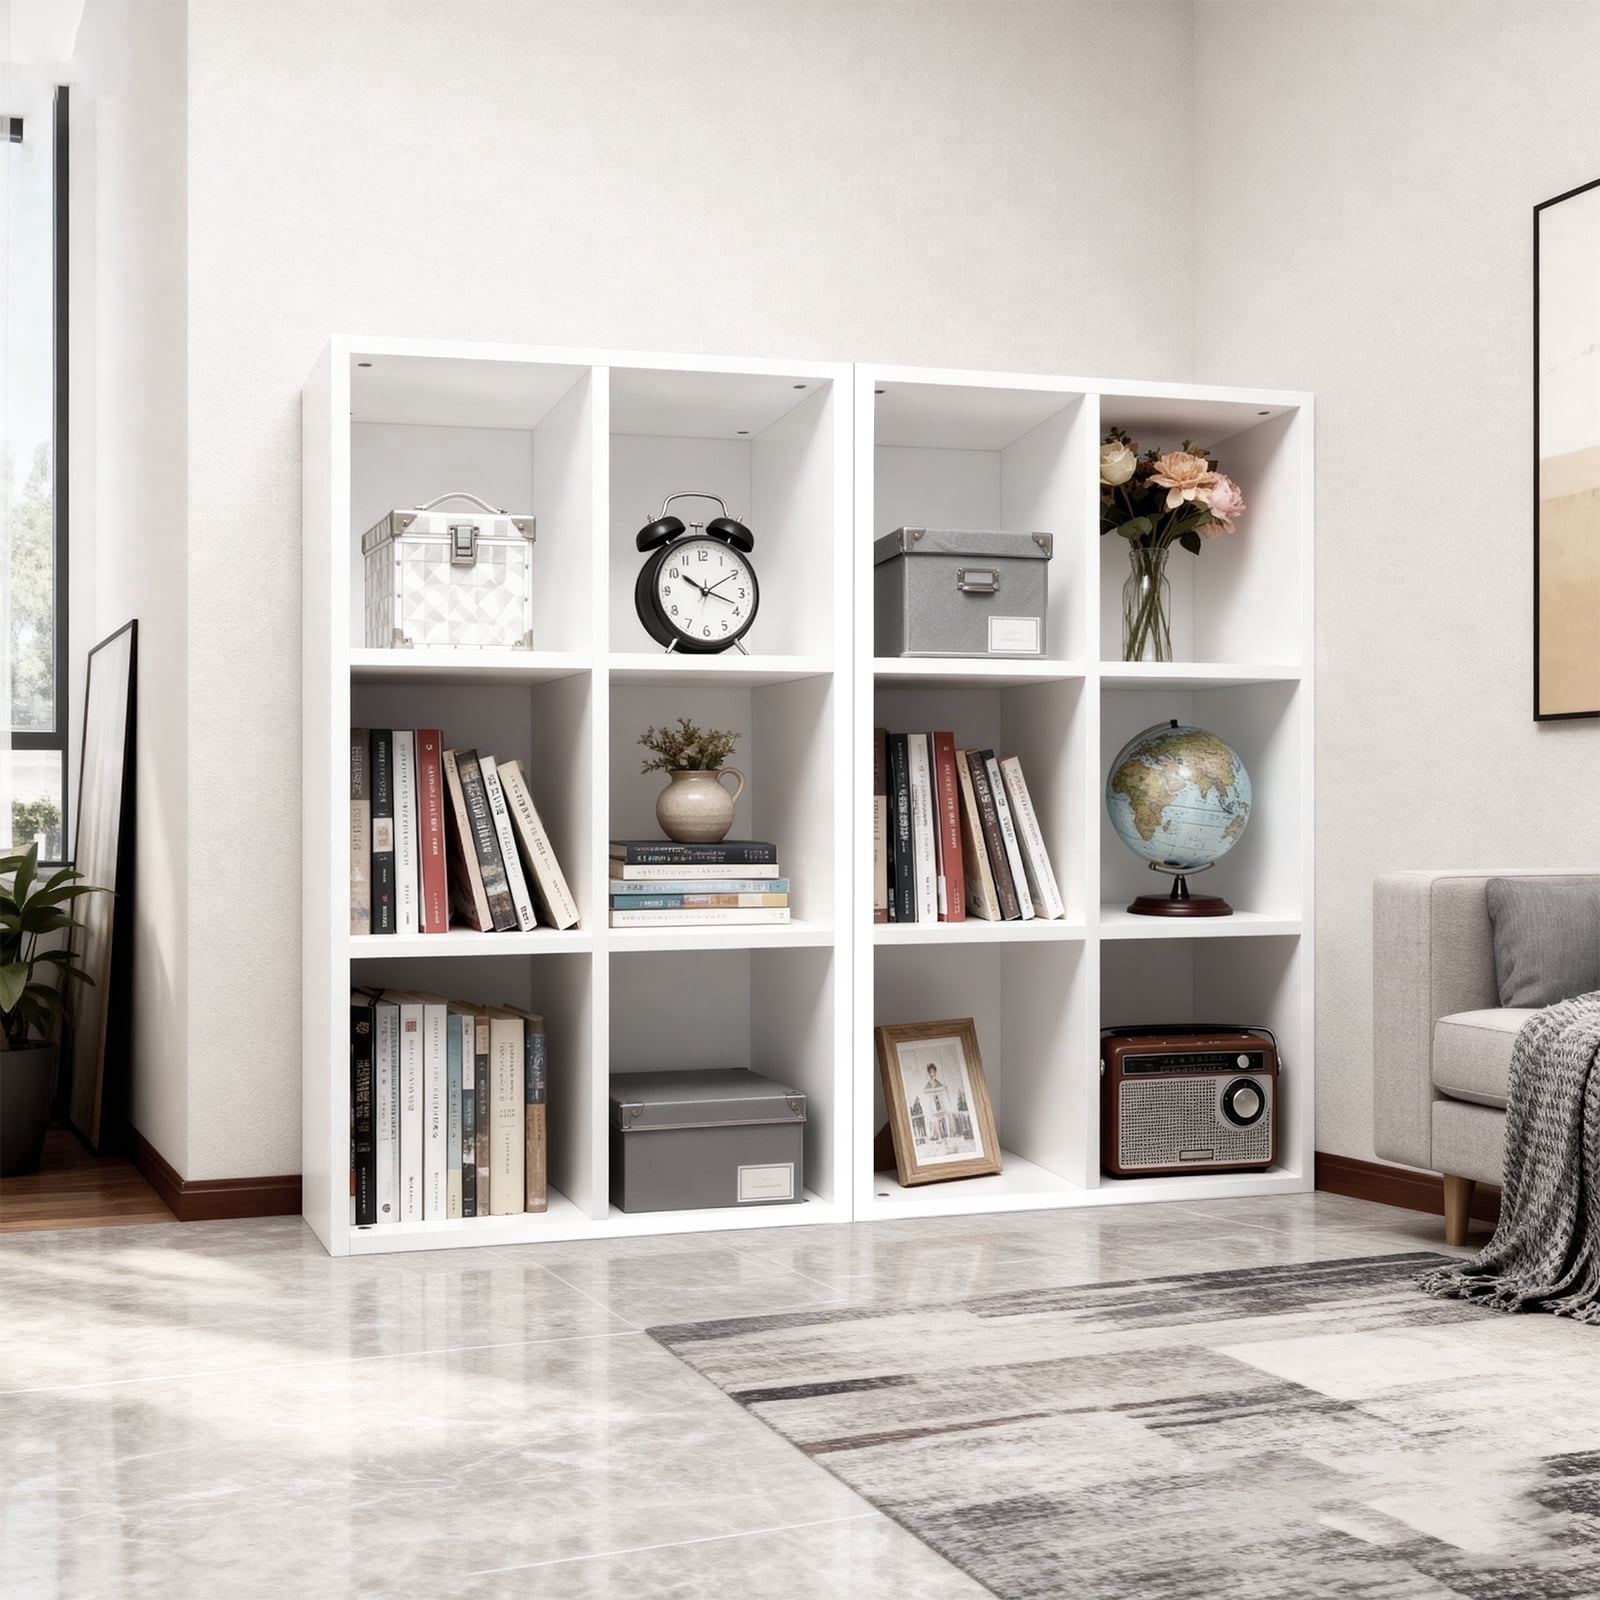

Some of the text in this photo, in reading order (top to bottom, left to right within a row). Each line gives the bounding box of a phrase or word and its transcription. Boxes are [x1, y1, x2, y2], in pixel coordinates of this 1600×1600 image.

[682, 556, 689, 566] 11
[698, 551, 708, 561] 12
[669, 568, 679, 578] 10
[731, 570, 739, 580] 2
[664, 586, 671, 596] 9
[738, 588, 745, 598] 3
[671, 605, 678, 616] 8
[732, 606, 740, 616] 4
[685, 618, 692, 629] 7
[721, 620, 728, 631] 5
[703, 626, 711, 637] 6
